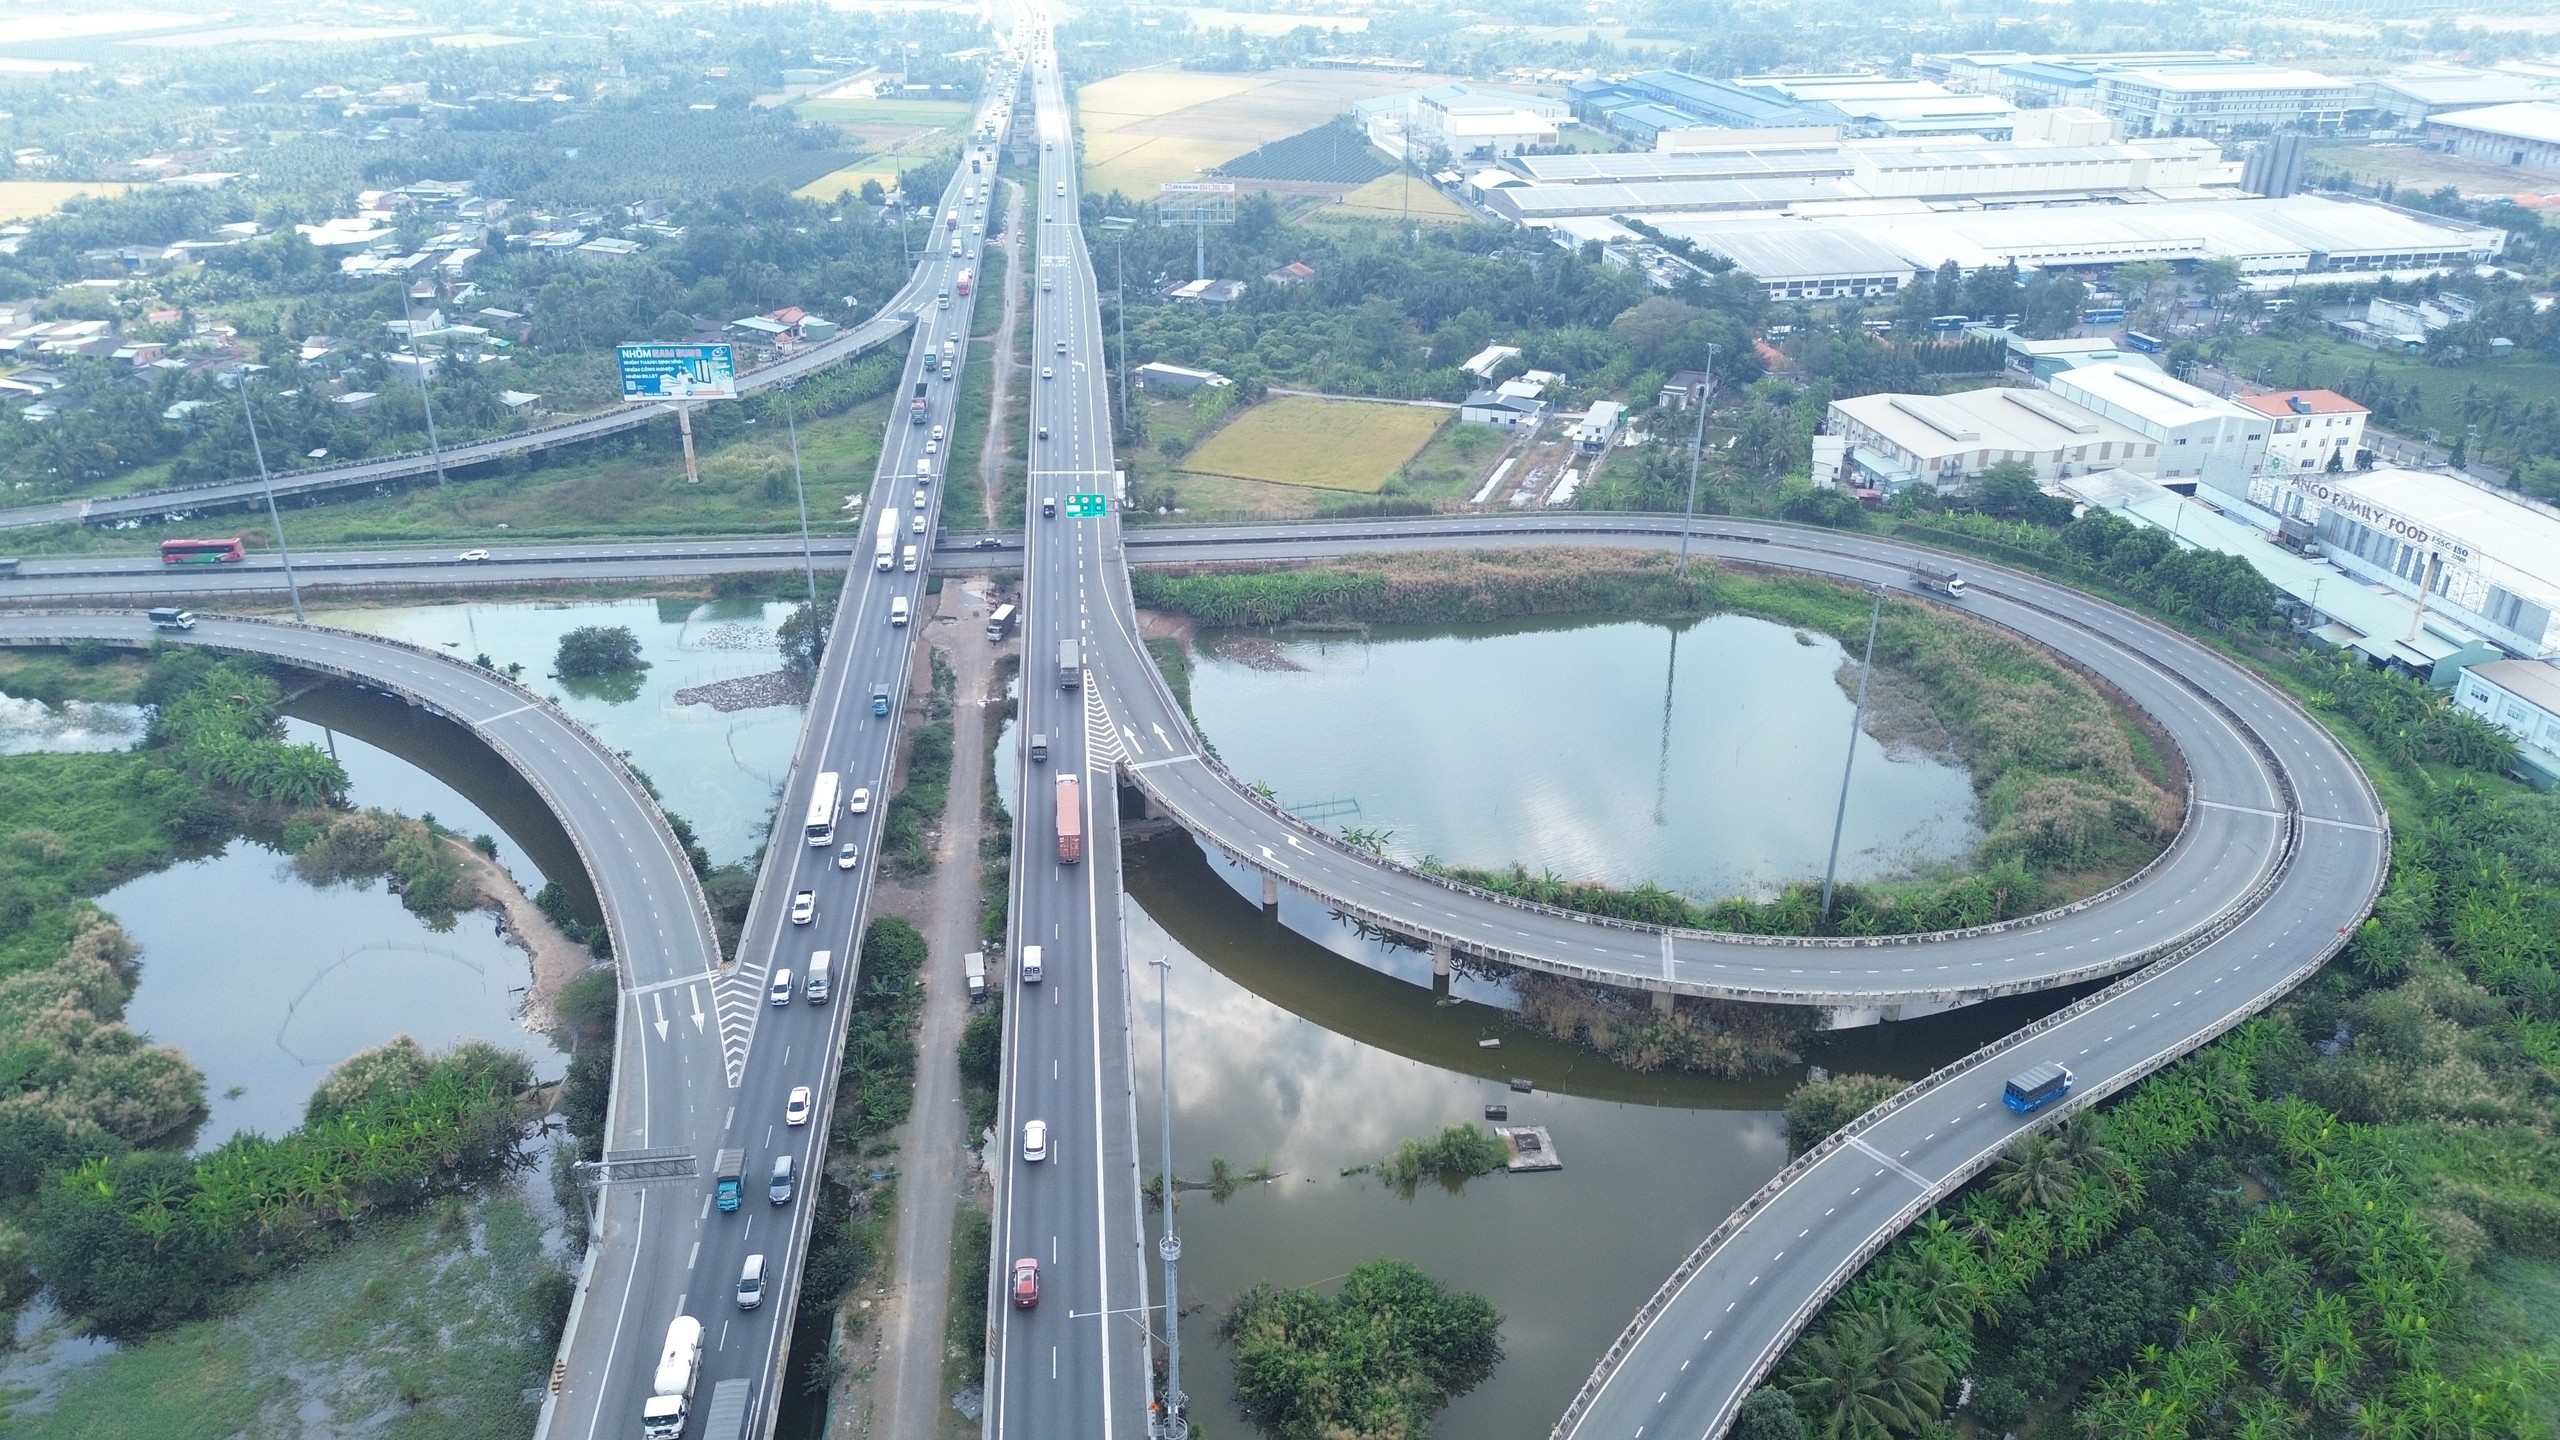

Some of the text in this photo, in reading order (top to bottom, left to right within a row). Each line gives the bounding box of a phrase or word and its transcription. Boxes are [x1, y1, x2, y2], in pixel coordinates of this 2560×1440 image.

[621, 347, 652, 358] NHÔM
[2290, 475, 2428, 543] ANCO FAMILY FOOD
[2453, 545, 2469, 557] ISO
